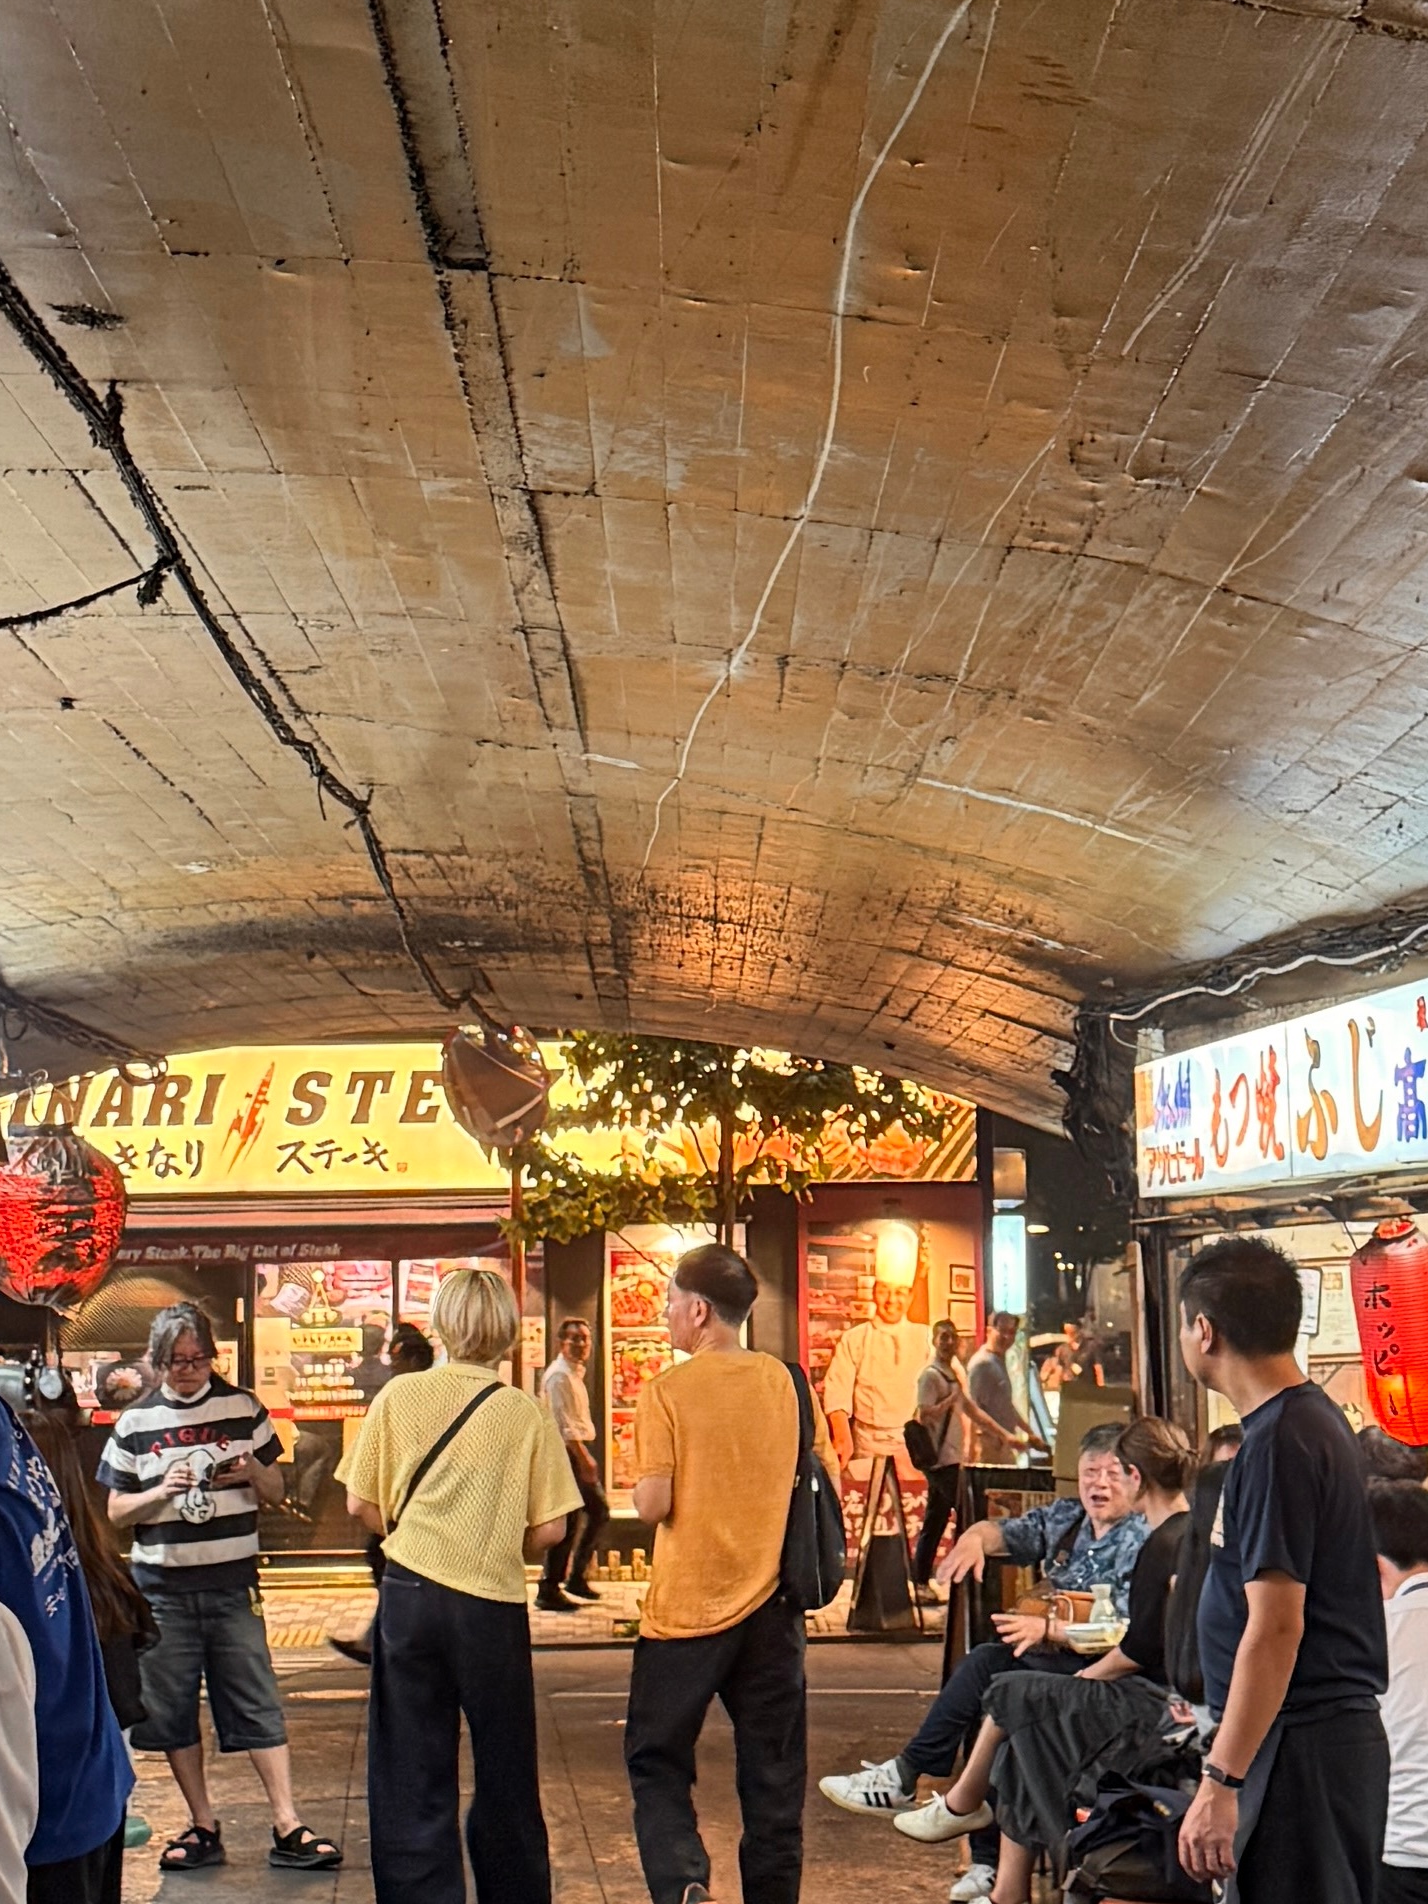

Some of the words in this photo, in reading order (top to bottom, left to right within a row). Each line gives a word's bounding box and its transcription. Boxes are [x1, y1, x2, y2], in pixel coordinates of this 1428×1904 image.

[285, 1071, 448, 1125] STE
[1211, 1044, 1285, 1167] もつ焼
[1297, 1016, 1383, 1161] ふじ
[113, 1138, 204, 1179] きなり
[276, 1136, 390, 1175] ステーキ
[1146, 1138, 1204, 1187] アサヒビール
[253, 1245, 278, 1258] Cut
[1364, 1282, 1400, 1415] ホッピー
